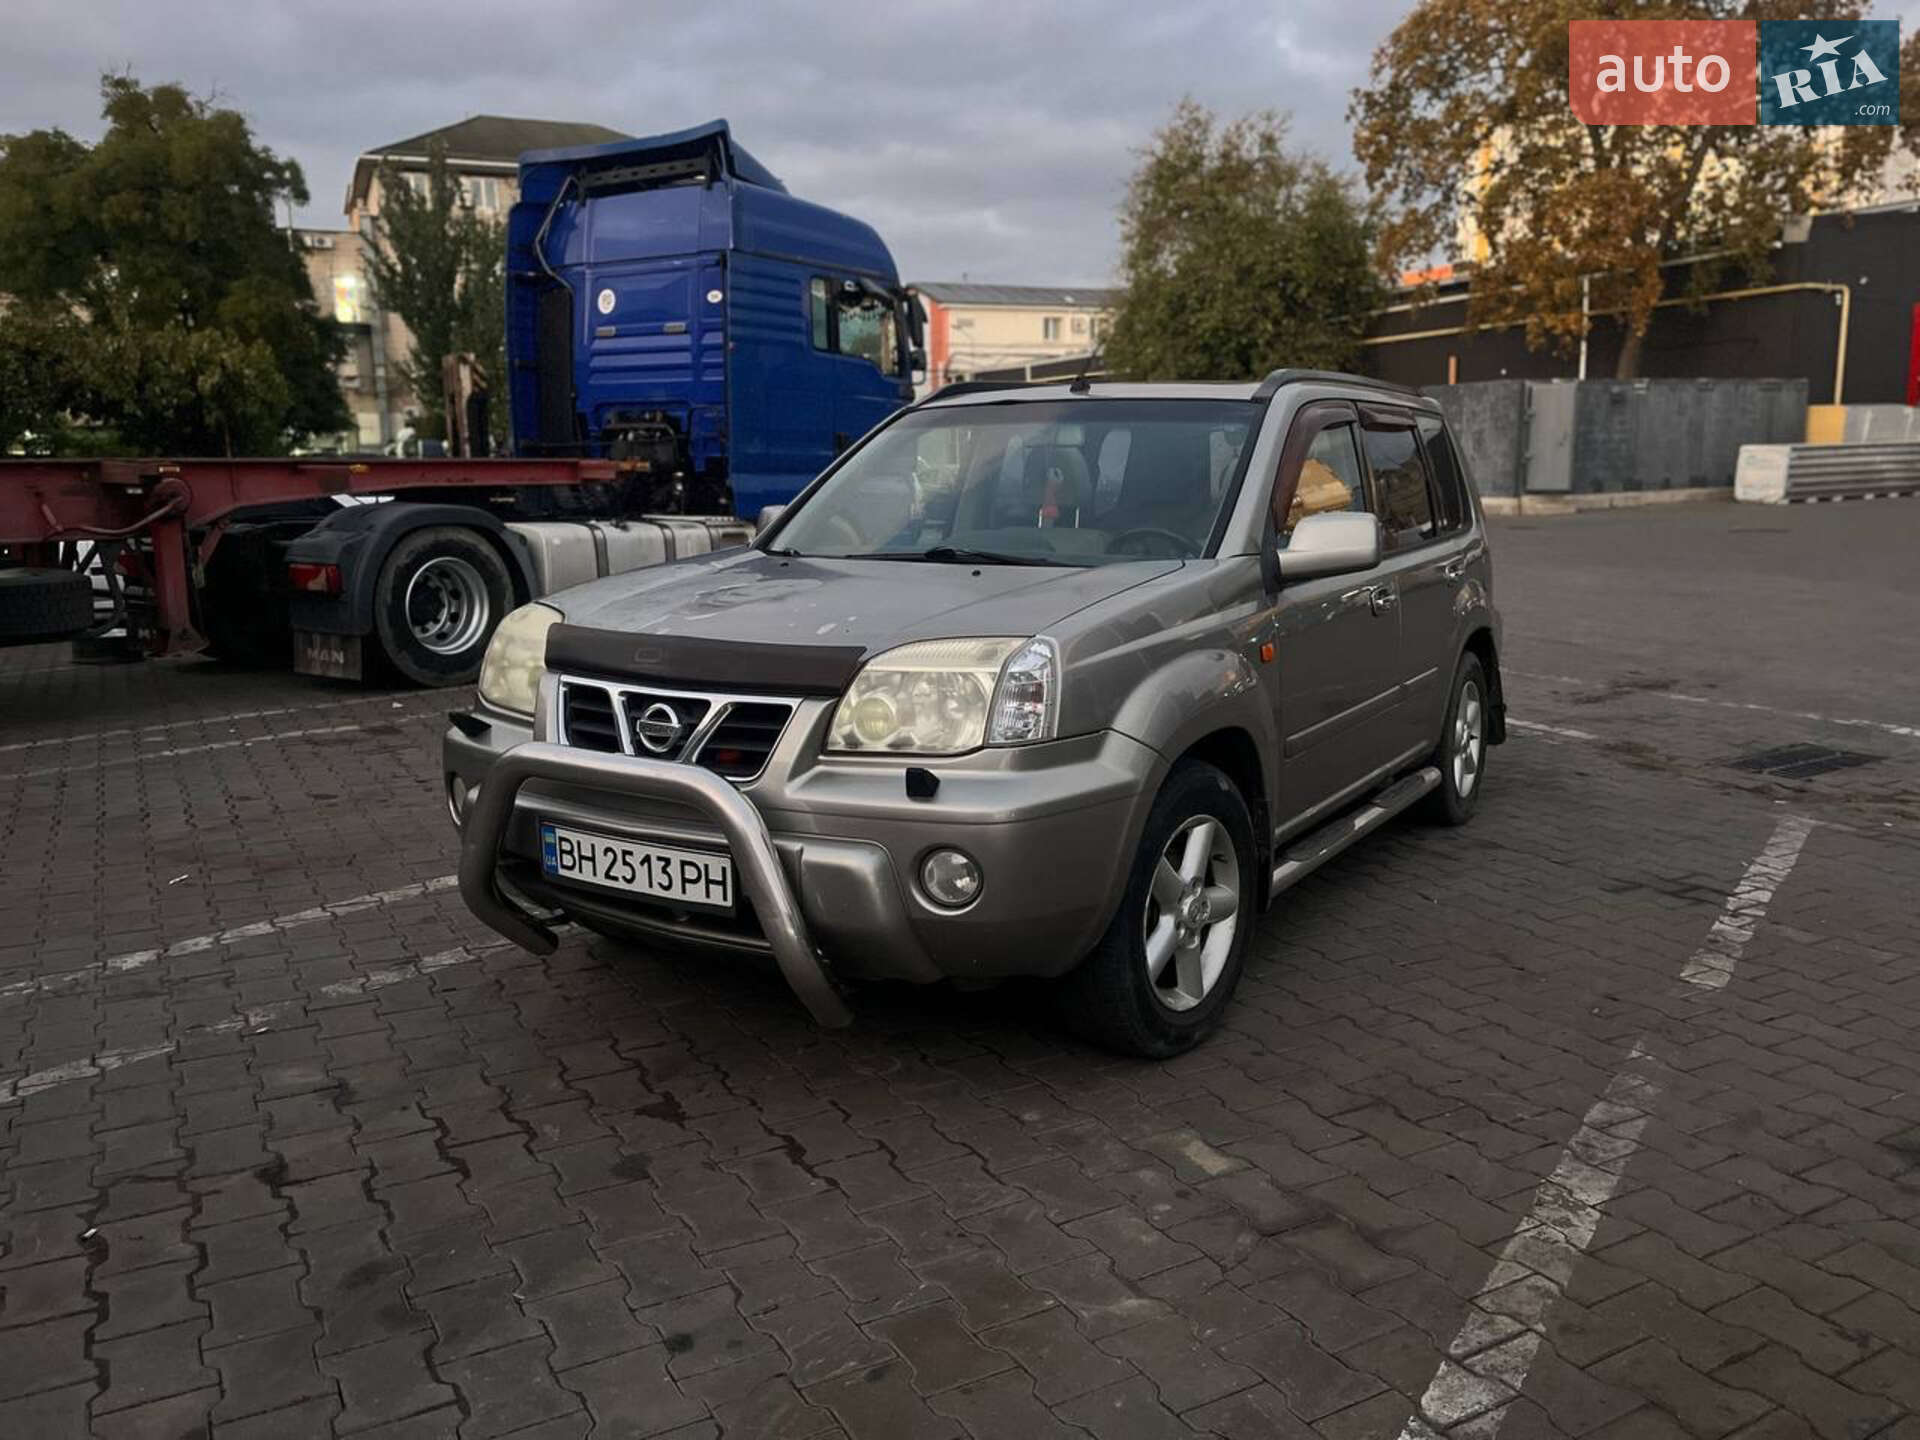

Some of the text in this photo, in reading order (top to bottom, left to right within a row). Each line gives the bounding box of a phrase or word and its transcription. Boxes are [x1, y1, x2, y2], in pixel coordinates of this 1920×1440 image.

[306, 648, 344, 664] MAN
[545, 855, 558, 866] UA
[558, 836, 729, 902] BH 2513 PH
